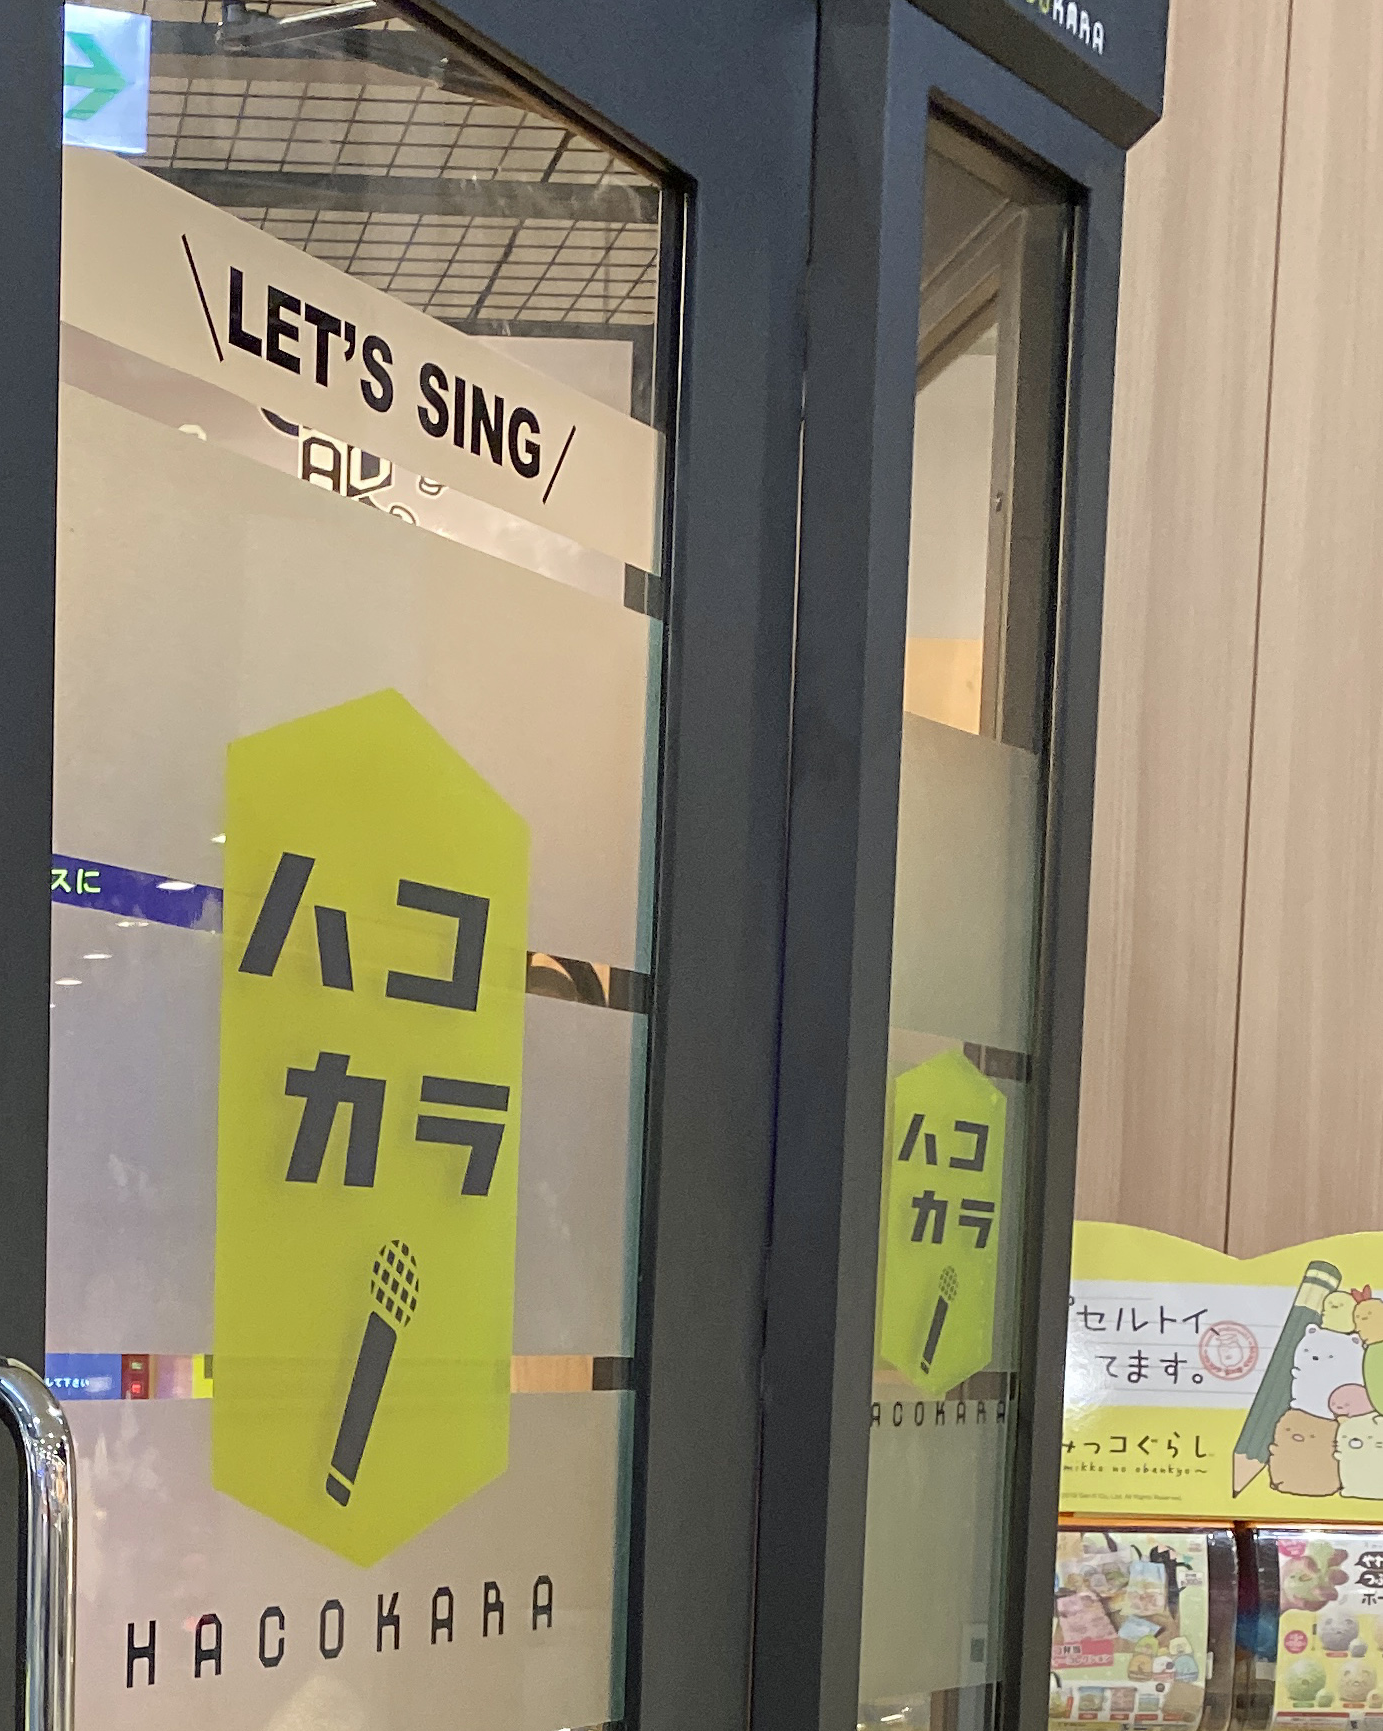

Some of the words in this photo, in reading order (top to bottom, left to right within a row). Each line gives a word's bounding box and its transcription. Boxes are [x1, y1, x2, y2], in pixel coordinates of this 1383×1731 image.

[1026, 0, 1105, 55] KARA
[228, 265, 394, 413] LET'S
[417, 361, 541, 479] SING
[51, 868, 101, 894] スに
[238, 851, 490, 1012] ハコ
[285, 1051, 510, 1197] カラ
[898, 1113, 989, 1172] ハコ
[911, 1190, 995, 1249] カラ
[1068, 1295, 1220, 1336] セルトイ、
[125, 1574, 554, 1689] HACOKARA
